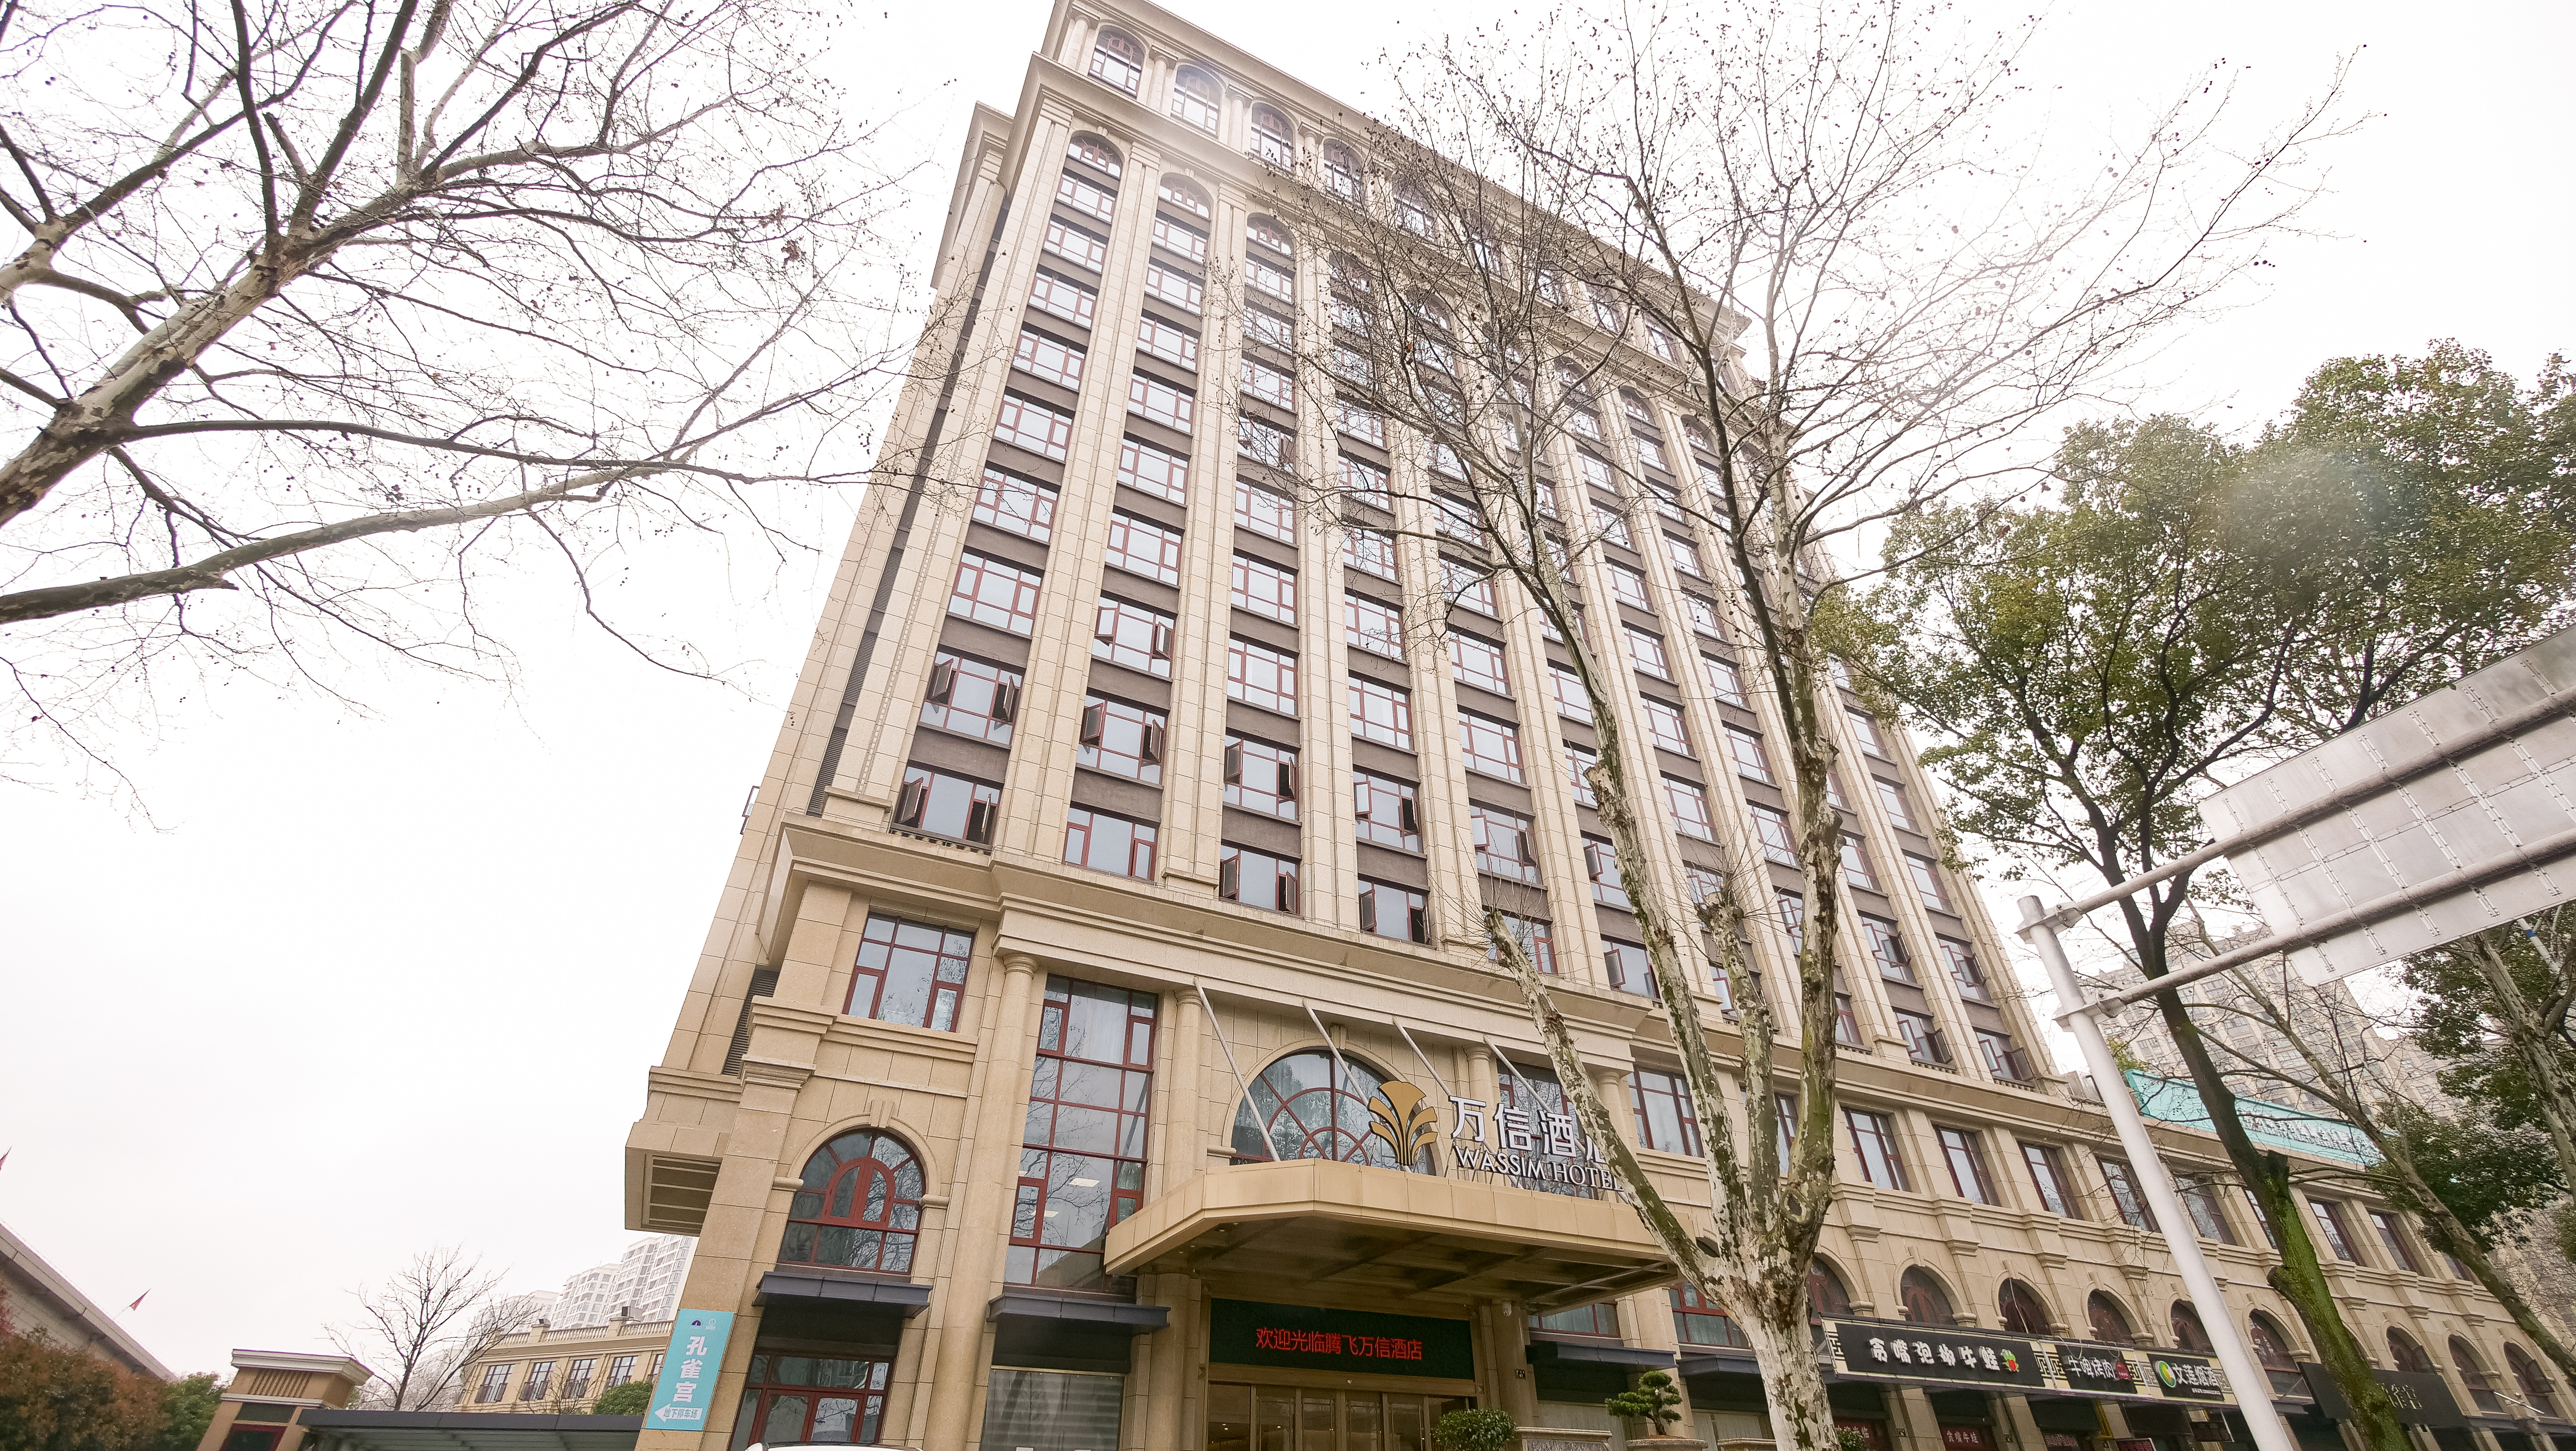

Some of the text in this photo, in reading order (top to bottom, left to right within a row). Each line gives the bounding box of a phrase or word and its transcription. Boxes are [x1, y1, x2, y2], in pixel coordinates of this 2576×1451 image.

[1454, 1145, 1624, 1192] WASSIM HOTEL
[1256, 1327, 1422, 1360] 欢迎光临腾飞万信酒店
[673, 1336, 708, 1403] 孔雀宫
[663, 1408, 699, 1419] 地下停车场
